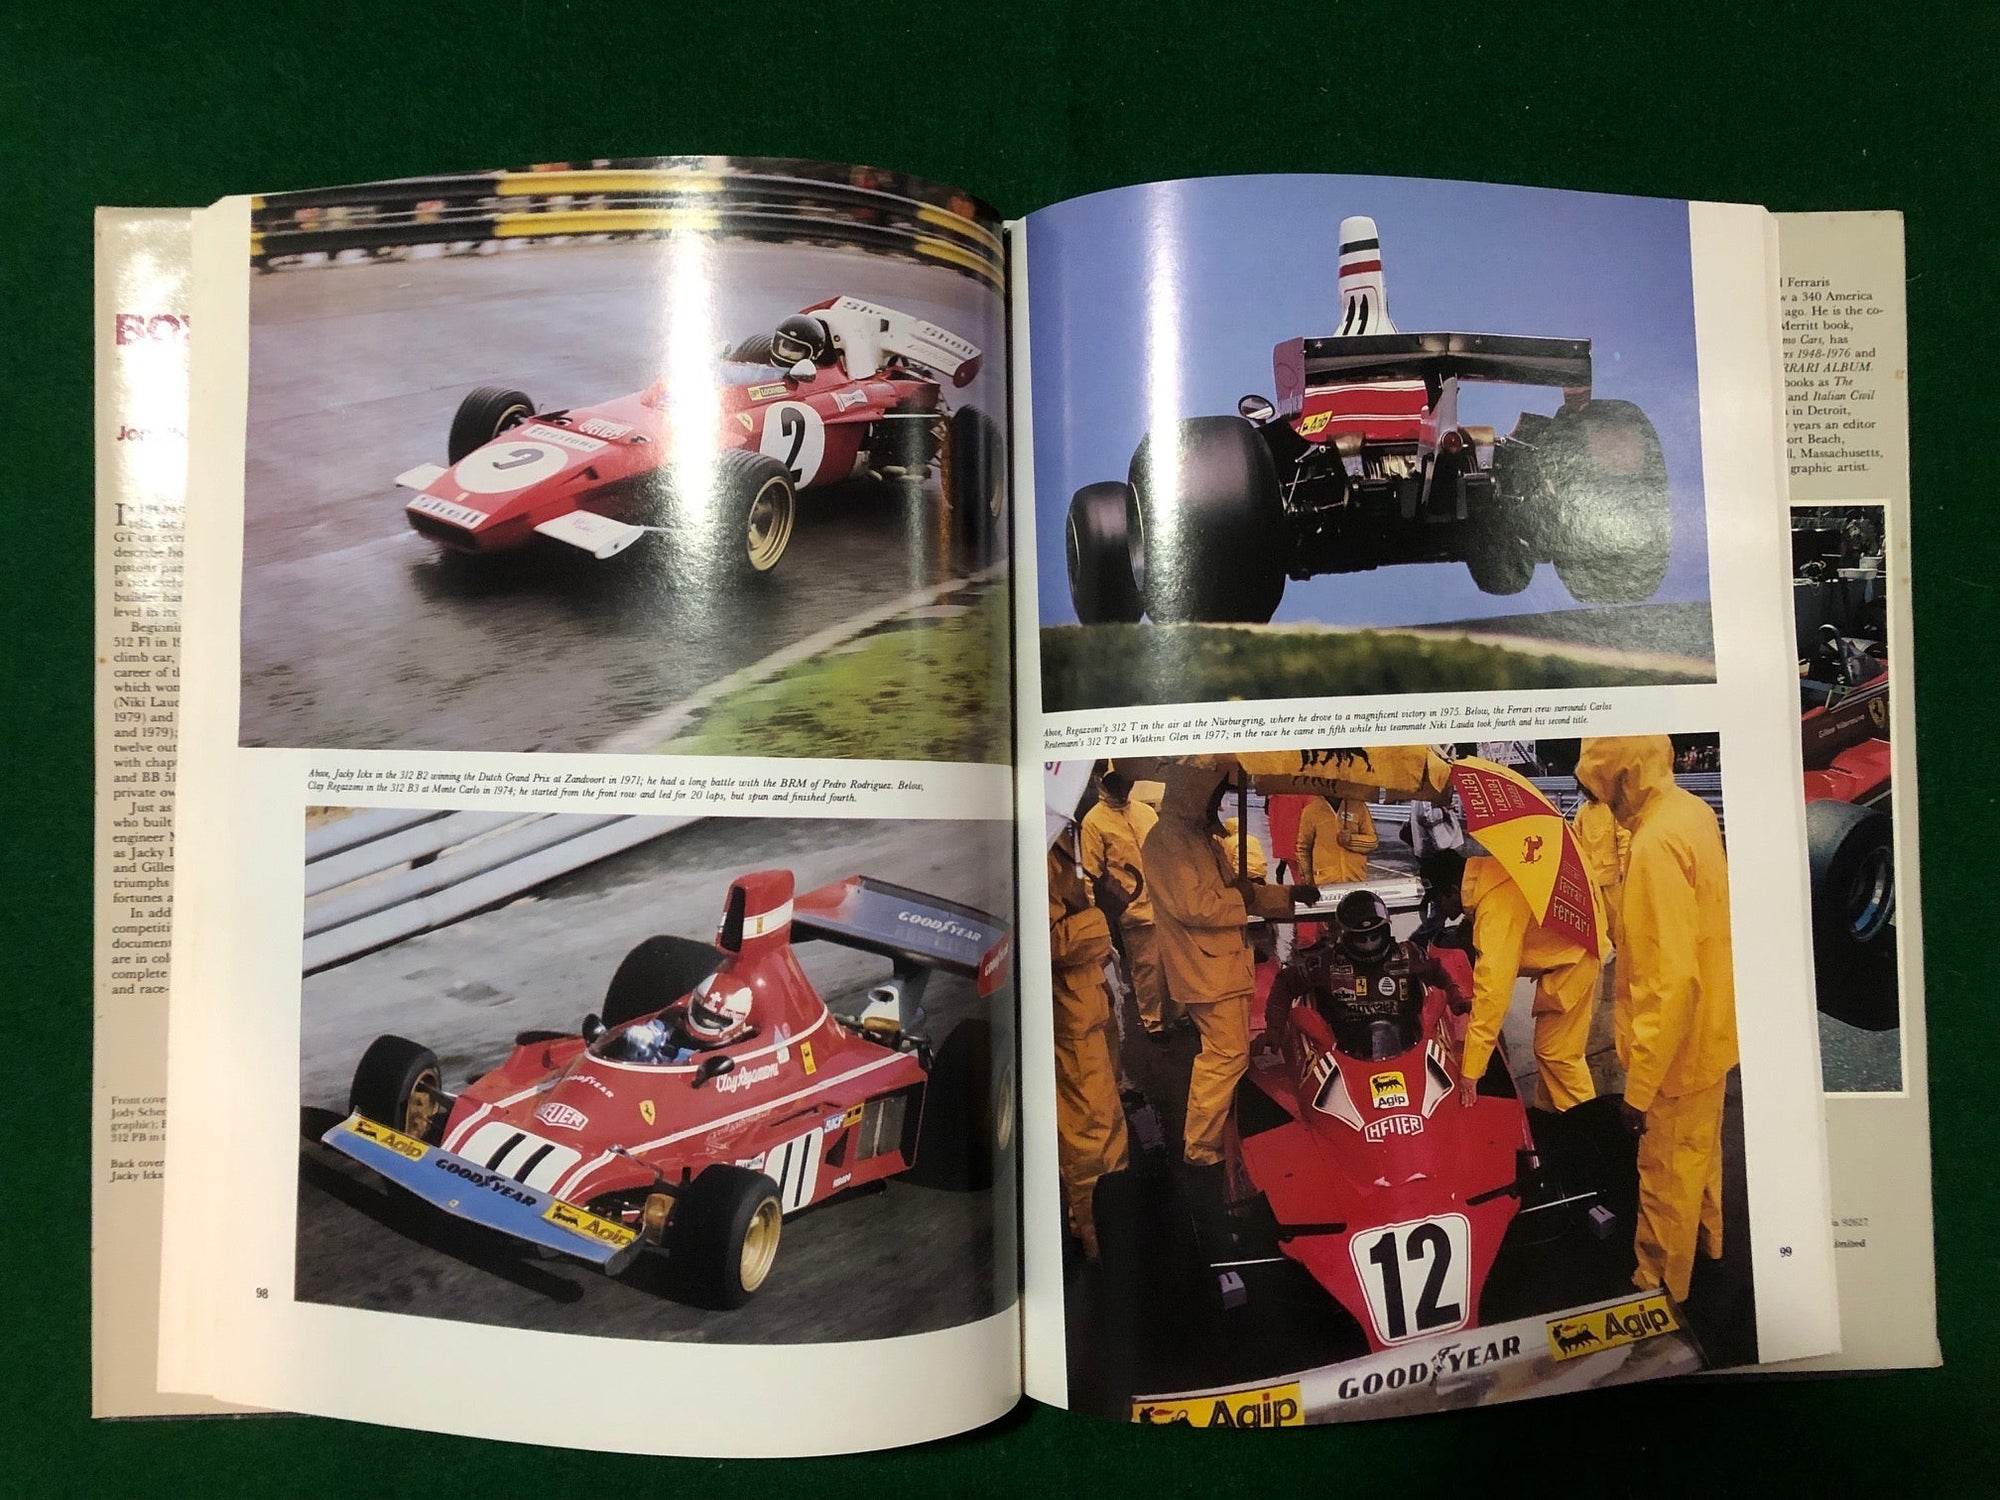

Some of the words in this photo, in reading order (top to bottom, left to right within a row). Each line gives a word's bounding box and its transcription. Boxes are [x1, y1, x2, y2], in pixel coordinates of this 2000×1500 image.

[1788, 277, 1830, 288] Ferraris
[1802, 292, 1822, 302] 340
[1826, 291, 1873, 301] America
[1845, 306, 1863, 315] the
[1823, 320, 1854, 331] book,
[923, 326, 974, 355] Shell
[1800, 334, 1825, 345] Cars,
[1829, 334, 1848, 344] has
[1798, 348, 1851, 359] 1948-1976
[1855, 348, 1876, 358] and
[1835, 376, 1853, 387] The
[1788, 392, 1808, 401] and
[1813, 390, 1846, 401] Italian
[1850, 390, 1875, 400] Civil
[1808, 405, 1851, 416] Detroit,
[1793, 422, 1821, 432] years
[1843, 419, 1876, 430] editor
[781, 407, 805, 482] 2
[1808, 434, 1845, 445] Beach,
[493, 448, 545, 470] 2
[1801, 448, 1883, 459] Massachusetts,
[1791, 463, 1832, 475] graphic
[1838, 462, 1868, 473] artist.
[419, 496, 482, 525] Shell
[114, 652, 149, 662] climb
[153, 655, 175, 664] car,
[114, 669, 151, 677] career
[114, 682, 150, 692] which
[114, 696, 146, 709] (Niki
[114, 712, 147, 724] 1979)
[150, 712, 173, 722] and
[1110, 722, 1126, 732] 312
[1269, 714, 1295, 724] where
[1310, 712, 1332, 722] drove
[1353, 709, 1398, 722] magnificent
[1401, 710, 1427, 720] victory
[1440, 706, 1461, 716] 1975.
[1464, 706, 1490, 716] Below,
[1506, 704, 1532, 714] Ferrari
[1589, 701, 1611, 711] Carlos
[114, 727, 137, 737] and
[142, 727, 178, 739] 1979);
[1086, 736, 1101, 746] 312
[1104, 735, 1117, 745] T2
[1132, 733, 1166, 743] Watkins
[1168, 732, 1189, 741] Glen
[1204, 729, 1229, 740] 1977;
[1326, 724, 1346, 736] fifth
[1349, 723, 1372, 733] while
[1389, 722, 1426, 731] teammate
[1449, 719, 1474, 729] Lauda
[1476, 718, 1492, 728] took
[1492, 717, 1516, 730] fourth
[1548, 715, 1571, 725] second
[1572, 715, 1588, 724] title.
[114, 742, 153, 752] twelve
[331, 768, 354, 780] Jacky
[356, 769, 373, 778] Ickx
[399, 770, 414, 780] 312
[415, 770, 429, 780] B2
[477, 771, 502, 781] Dutch
[505, 772, 530, 782] Grand
[532, 773, 551, 782] Prix
[564, 773, 605, 784] Zandvoort
[620, 775, 643, 786] 1971;
[710, 777, 735, 786] battle
[779, 778, 807, 788] BRM
[822, 778, 847, 789] Pedro
[849, 779, 893, 792] Rodriguez.
[897, 780, 924, 791] Below,
[114, 787, 156, 800] private
[307, 780, 324, 792] Clay
[326, 781, 364, 793] Regazzoni
[390, 783, 405, 792] 312
[406, 783, 419, 792] B3
[431, 783, 456, 793] Monte
[458, 784, 480, 794] Carlo
[493, 785, 516, 796] 1974;
[530, 787, 559, 796] started
[558, 787, 579, 798] from
[595, 788, 617, 799] front
[658, 789, 672, 799] led
[690, 790, 703, 799] 20
[705, 790, 726, 802] laps,
[747, 792, 768, 803] spun
[789, 791, 827, 804] finished
[825, 792, 856, 804] fourth.
[1458, 771, 1496, 819] Ferrari
[1486, 777, 1513, 812] Ferrari
[129, 802, 154, 815] Just
[114, 817, 139, 827] who
[143, 817, 172, 827] built
[112, 832, 165, 846] engineer
[129, 847, 164, 861] Jacky
[113, 863, 137, 873] and
[142, 861, 174, 873] Gilles
[113, 877, 169, 890] triumphs
[1558, 875, 1587, 906] Ferrari
[113, 893, 162, 903] fortunes
[1552, 896, 1592, 938] Ferrari
[112, 968, 168, 982] complete
[140, 986, 169, 994] race-
[1377, 1094, 1406, 1108] Agip
[380, 1132, 423, 1158] Agip
[111, 1159, 135, 1168] Back
[780, 1134, 812, 1208] 11
[436, 1159, 538, 1207] GOODYEAR
[583, 1219, 633, 1246] Agip
[1780, 1246, 1792, 1257] 99
[1369, 1222, 1461, 1338] 12
[256, 1287, 269, 1299] 98
[1604, 1303, 1670, 1341] Agip
[1337, 1334, 1521, 1401] GOODYEAR
[1207, 1392, 1298, 1428] Agip
